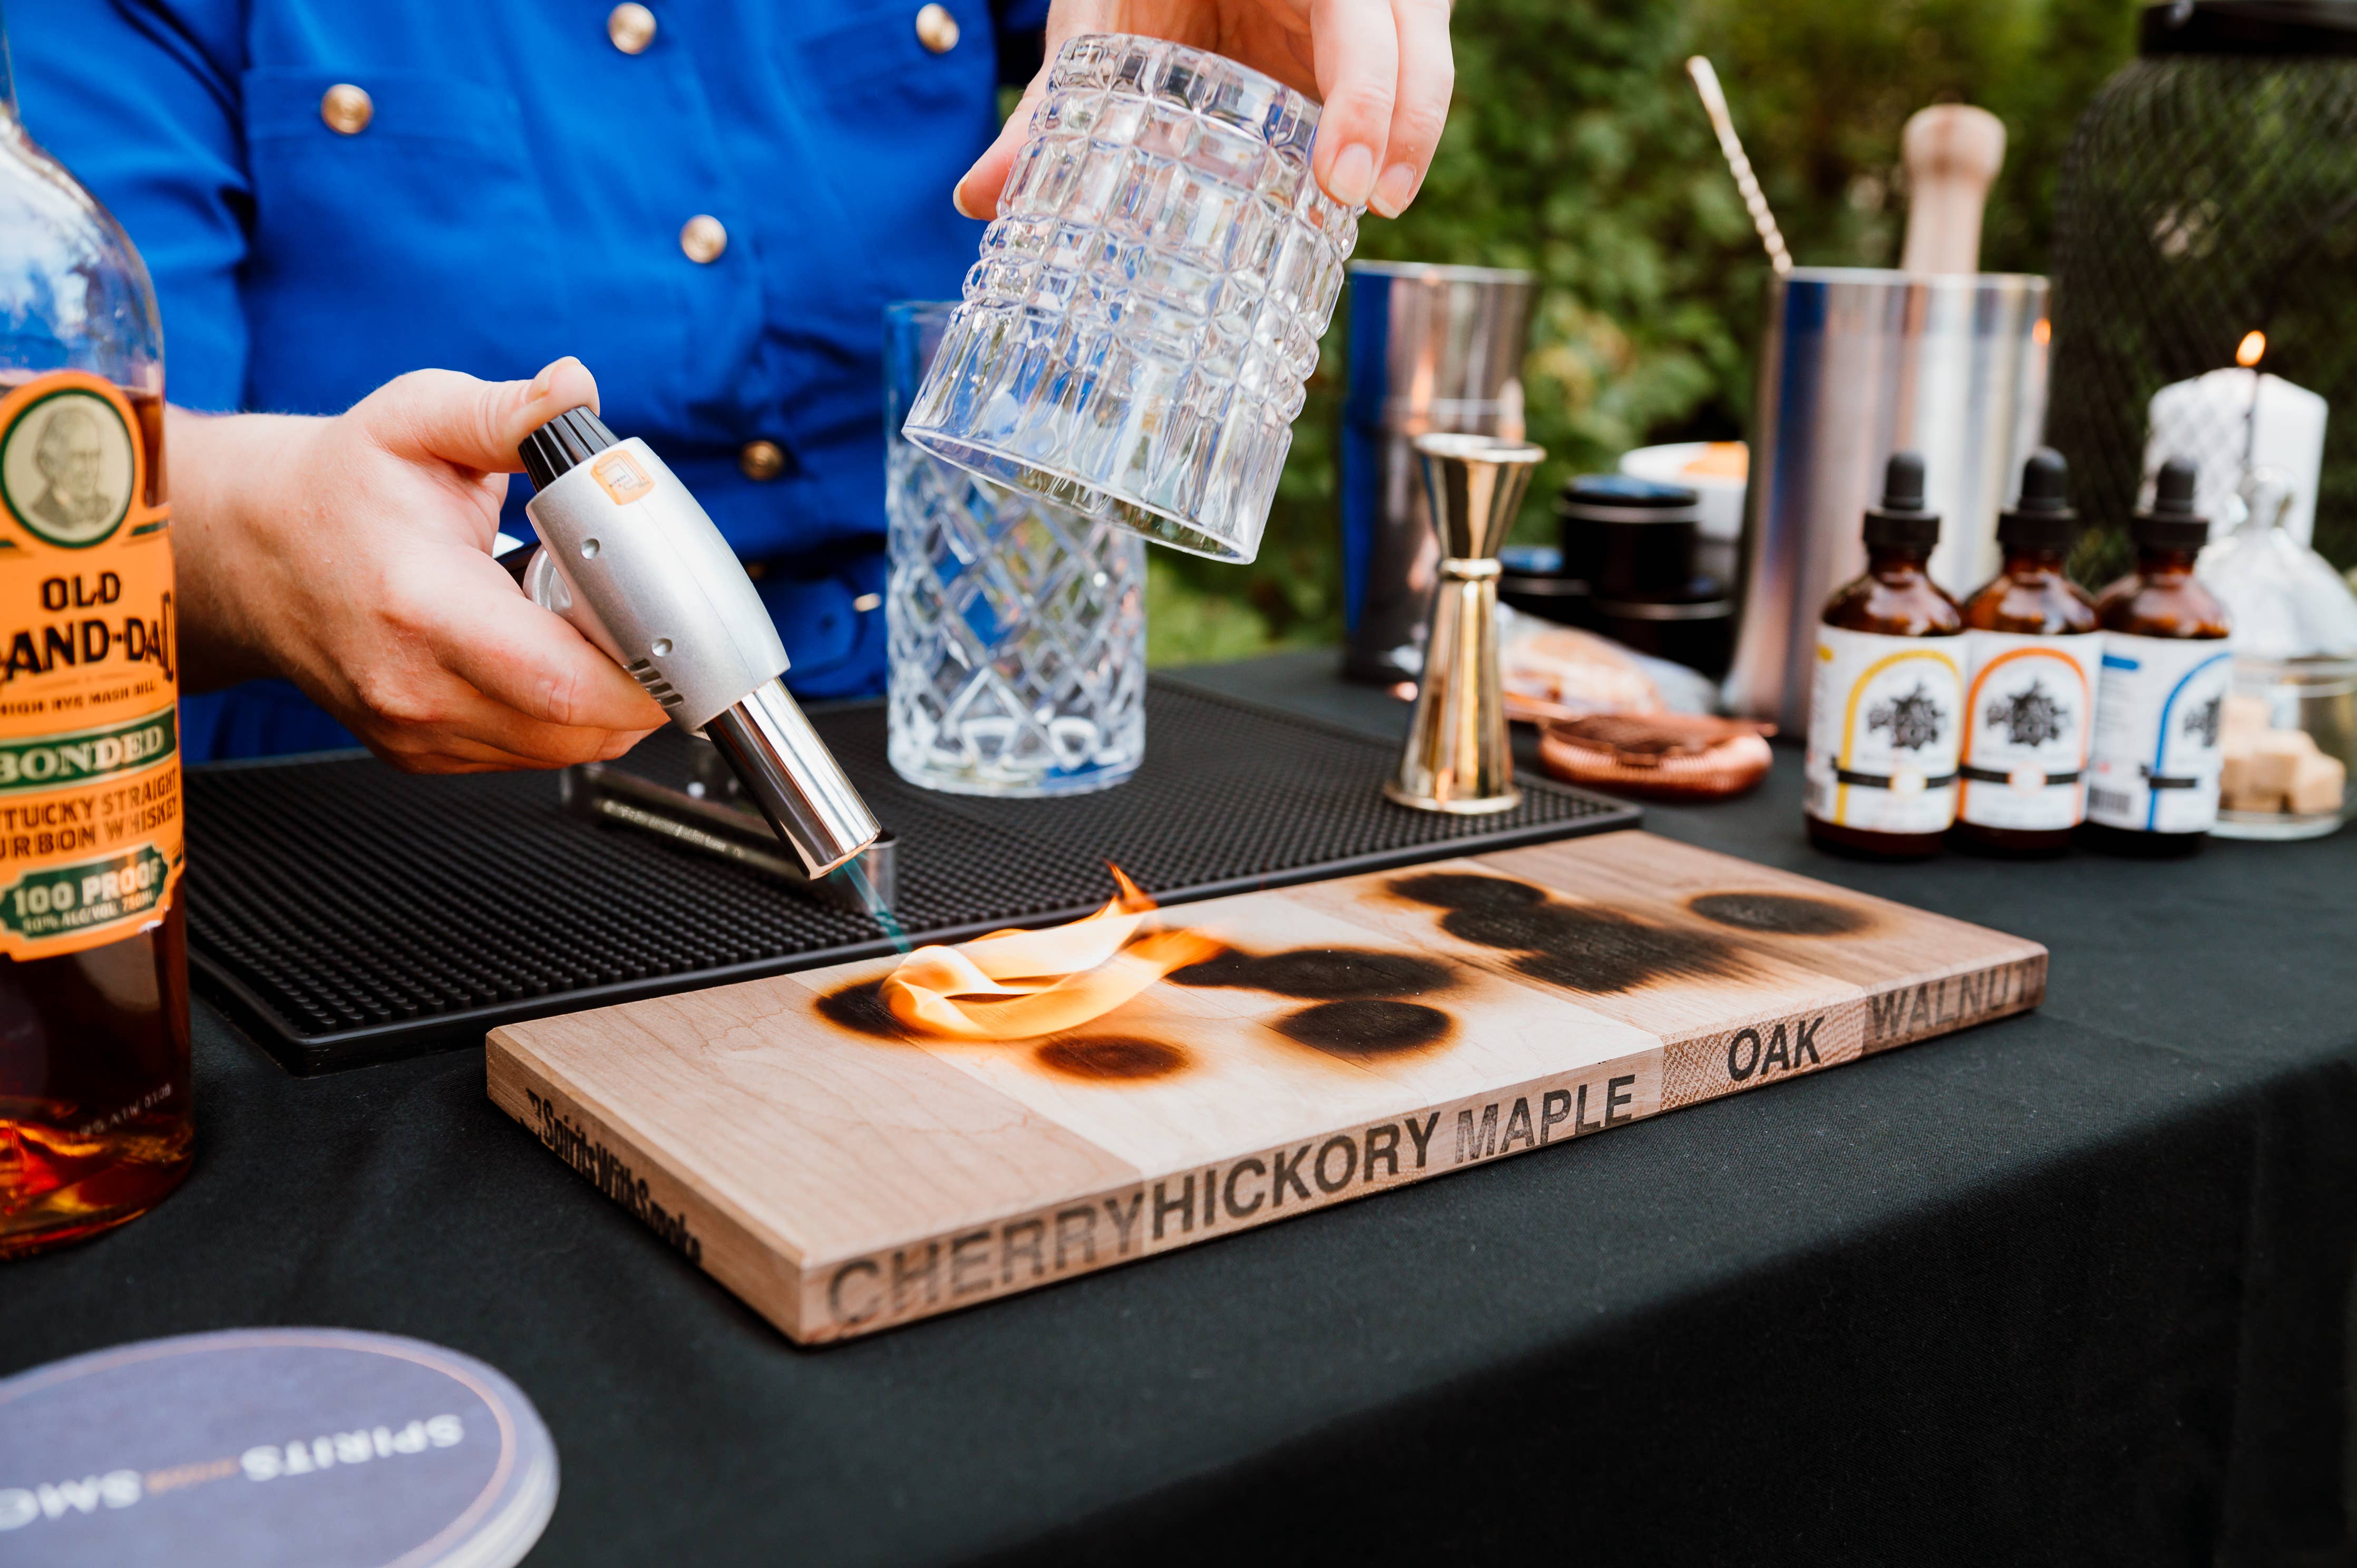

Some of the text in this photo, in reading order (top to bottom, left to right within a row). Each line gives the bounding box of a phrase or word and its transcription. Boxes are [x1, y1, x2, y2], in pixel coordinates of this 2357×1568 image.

[41, 571, 121, 611] OLD
[0, 590, 174, 683] AND-DAD
[52, 694, 83, 710] RYE
[89, 687, 128, 704] MASH
[133, 679, 155, 696] BILL
[0, 724, 164, 784] BONDED
[100, 767, 177, 816] STRAIGHT
[102, 792, 177, 844] WHISKEY
[13, 856, 160, 917] 100 PROOF
[826, 962, 2037, 1323] CHERRY HICKORY MAPLE OAK WALNUT
[240, 1414, 465, 1482] SPIRITS
